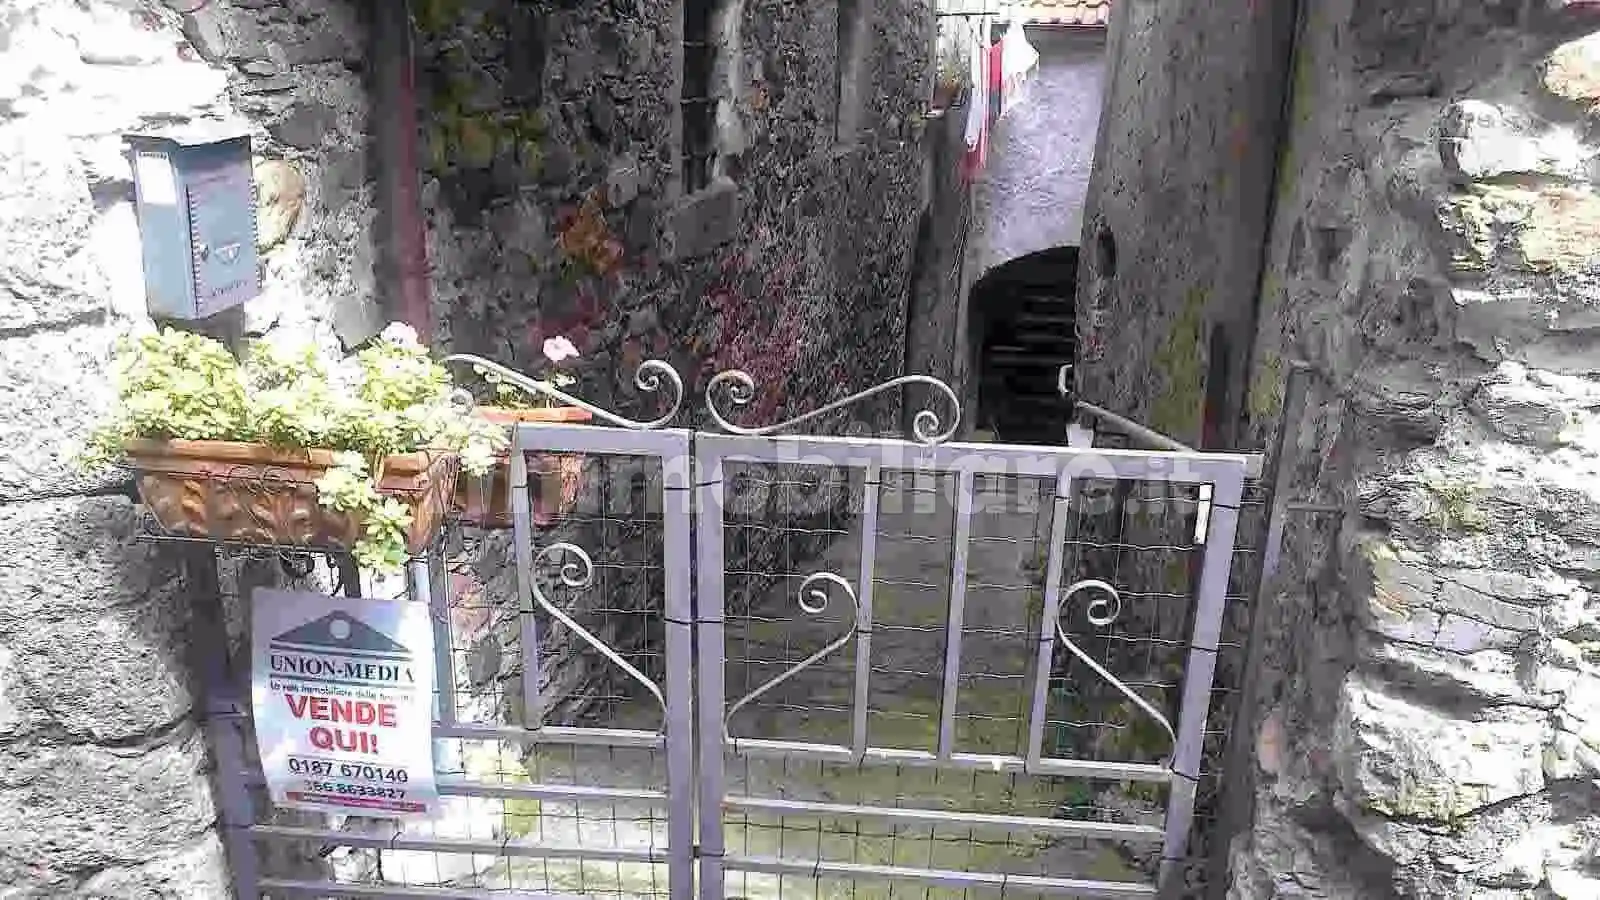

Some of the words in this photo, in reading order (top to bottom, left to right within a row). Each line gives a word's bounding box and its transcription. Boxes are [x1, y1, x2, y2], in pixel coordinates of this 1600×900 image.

[271, 655, 415, 683] UNION-MEDIA
[285, 694, 397, 727] VENDE
[309, 726, 379, 754] QUI!
[288, 758, 333, 776] 0187
[340, 763, 409, 783] 670140
